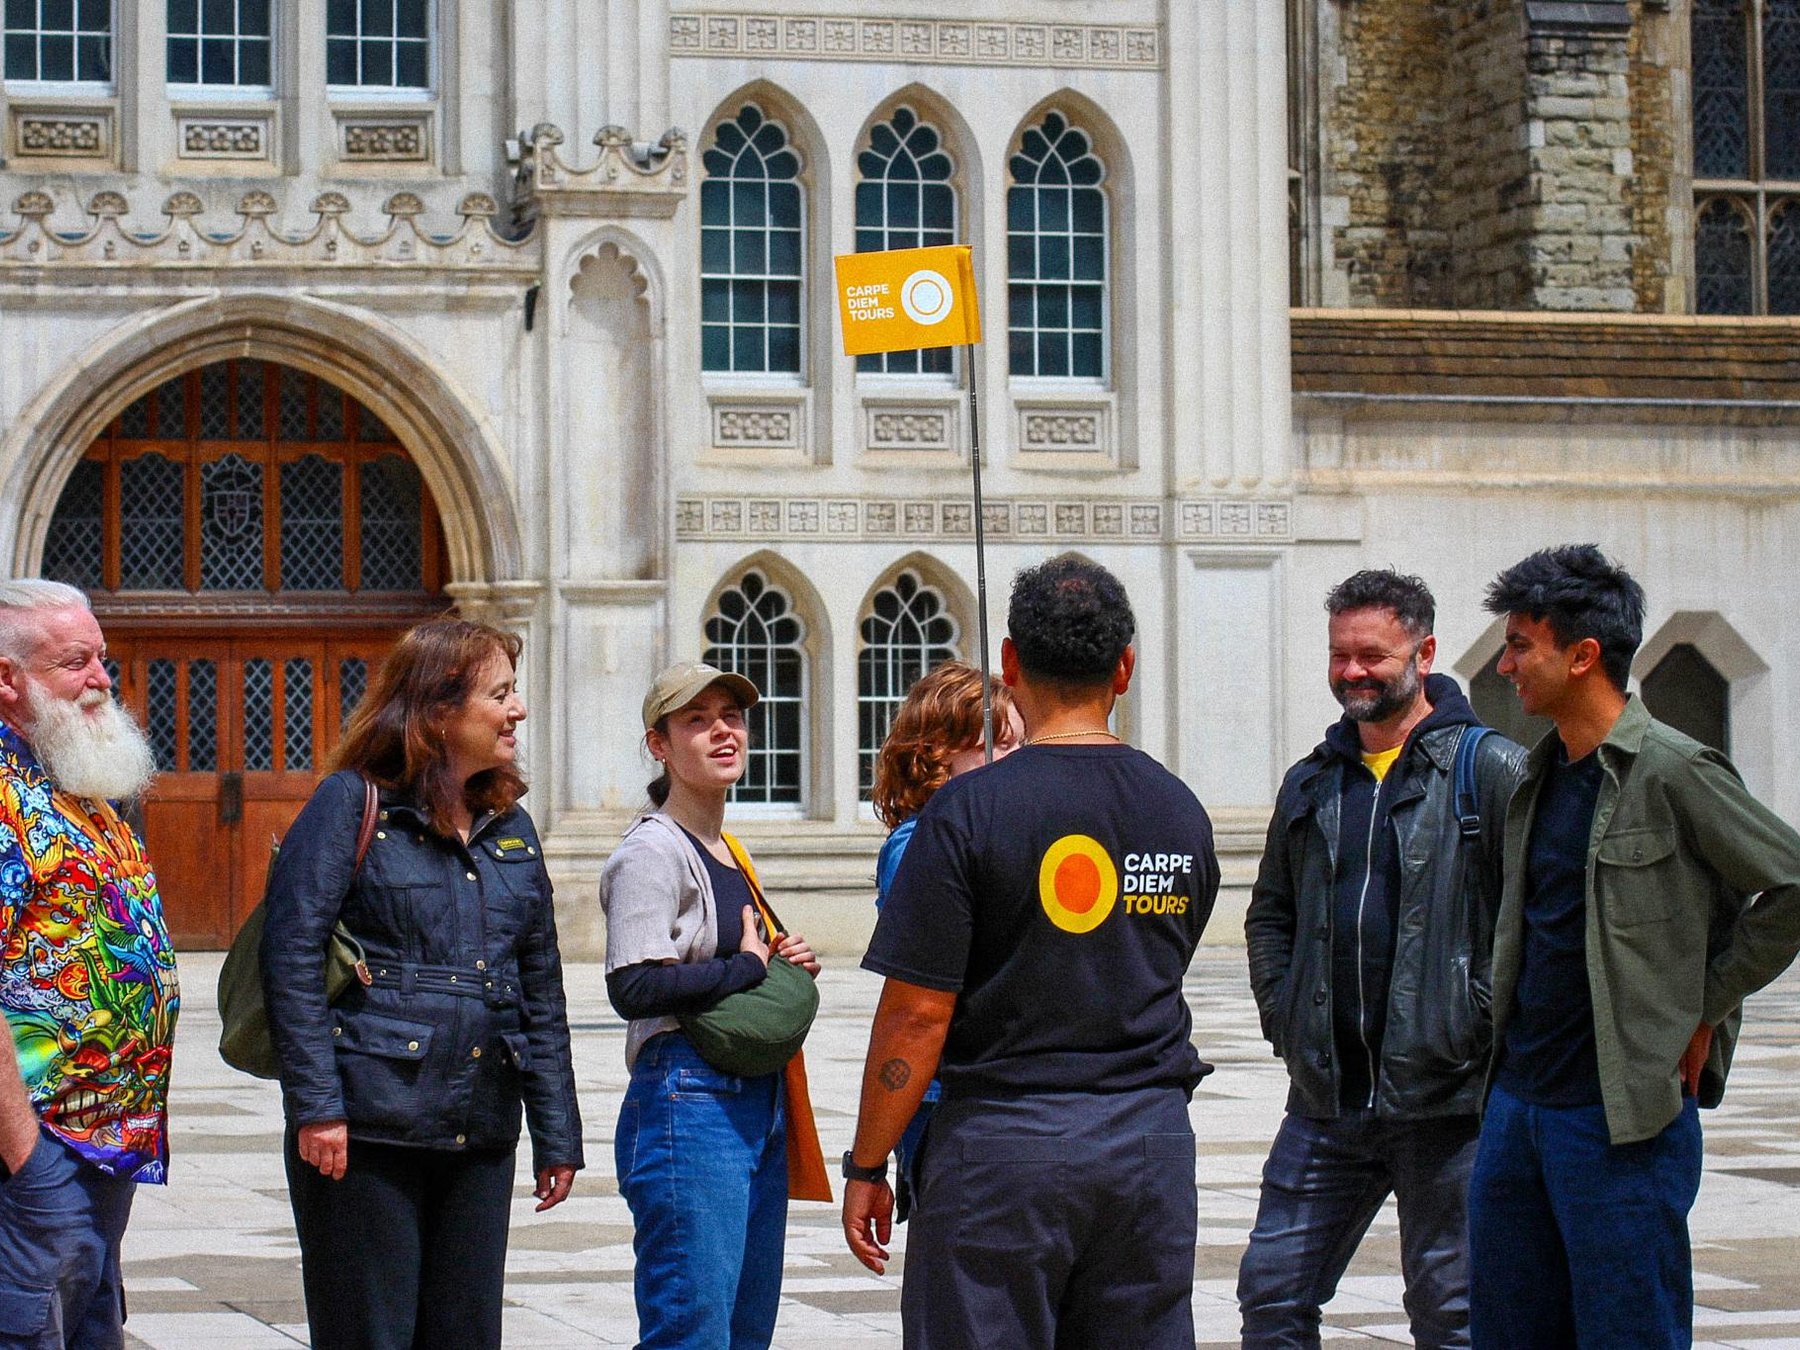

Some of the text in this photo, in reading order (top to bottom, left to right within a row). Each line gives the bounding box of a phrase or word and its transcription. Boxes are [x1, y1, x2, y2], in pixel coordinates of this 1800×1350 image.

[846, 284, 889, 297] CARPE
[847, 297, 878, 309] DIEM
[849, 307, 894, 322] TOURS
[1124, 853, 1193, 874] CARPE
[1123, 874, 1175, 893] DIEM
[1123, 895, 1189, 914] TOURS
